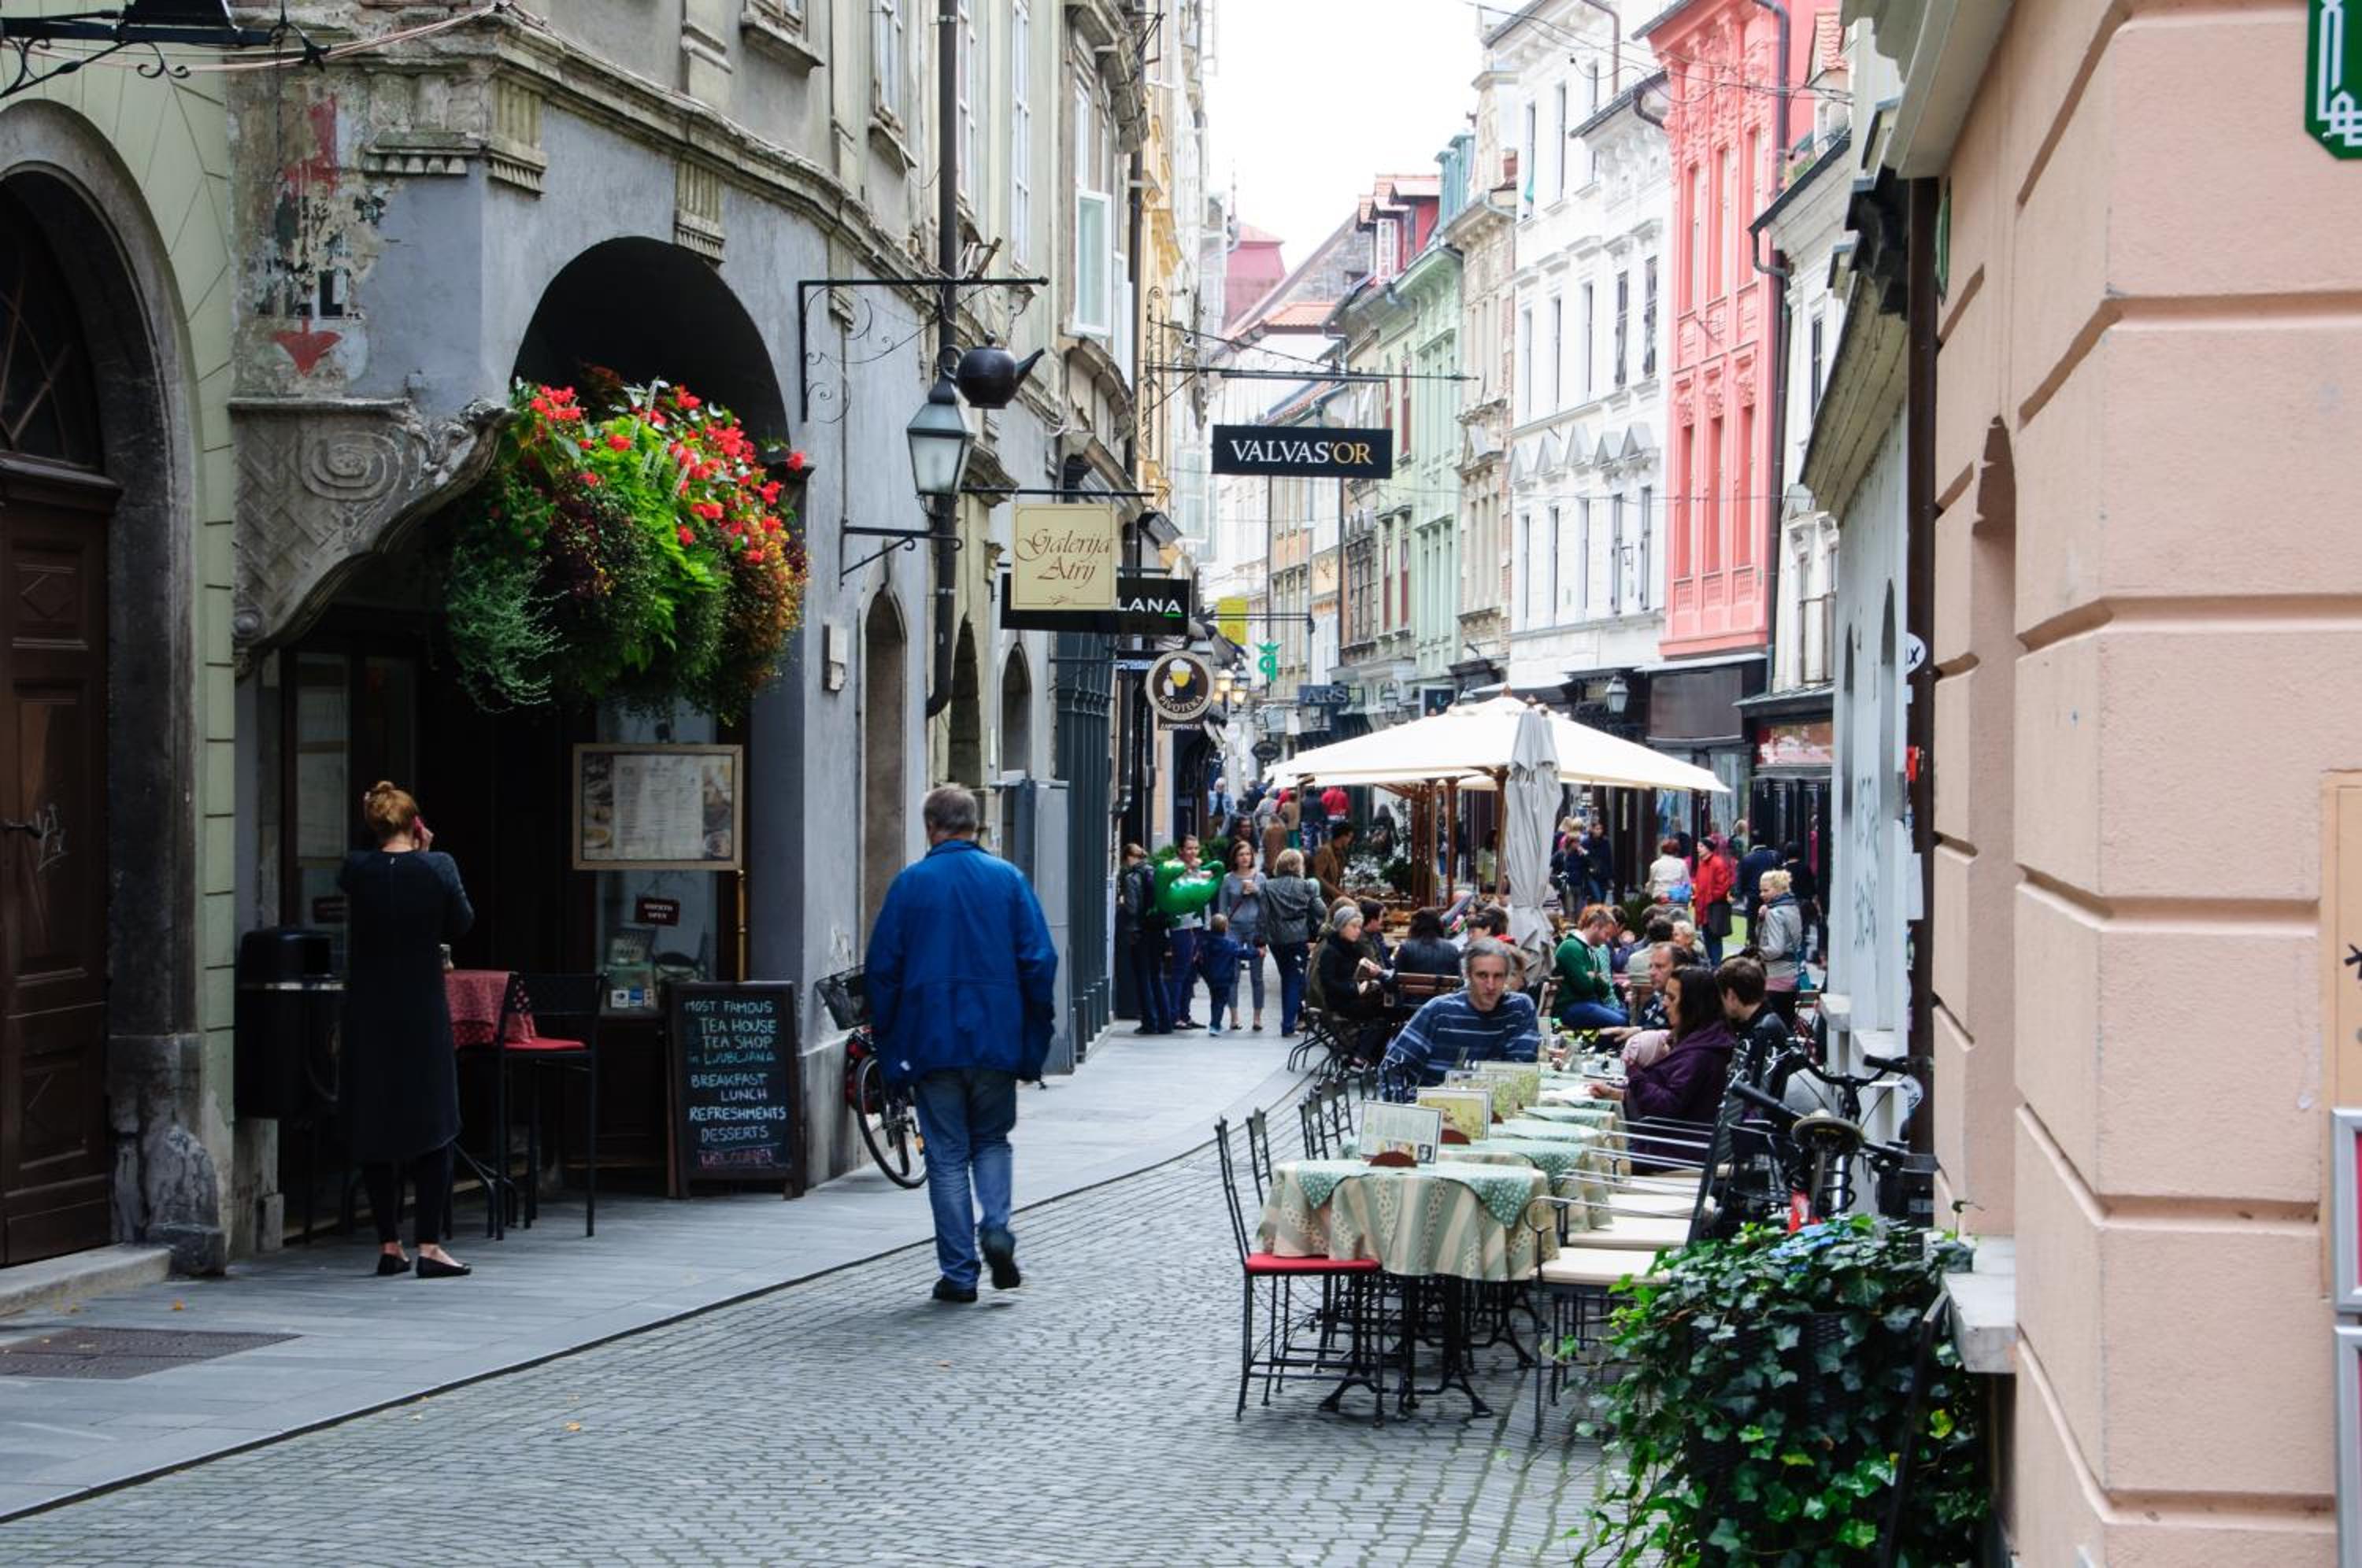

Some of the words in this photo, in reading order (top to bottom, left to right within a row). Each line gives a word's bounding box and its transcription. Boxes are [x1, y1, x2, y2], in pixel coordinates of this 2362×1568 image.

[1015, 528, 1115, 562] Galerija
[1037, 556, 1098, 590] Atrij
[1305, 686, 1348, 704] ARS
[684, 1000, 716, 1013] MOST
[724, 1000, 773, 1015] FAMOUS
[699, 1017, 728, 1035] TEA
[731, 1019, 777, 1035] HOUSE
[703, 1035, 731, 1049] TEA
[733, 1035, 773, 1050] SHOP
[690, 1073, 769, 1089] BREAKFAST
[720, 1087, 768, 1102] LUNCH
[689, 1105, 787, 1122] REFRESHMENTS
[700, 1126, 770, 1144] DESSERTS
